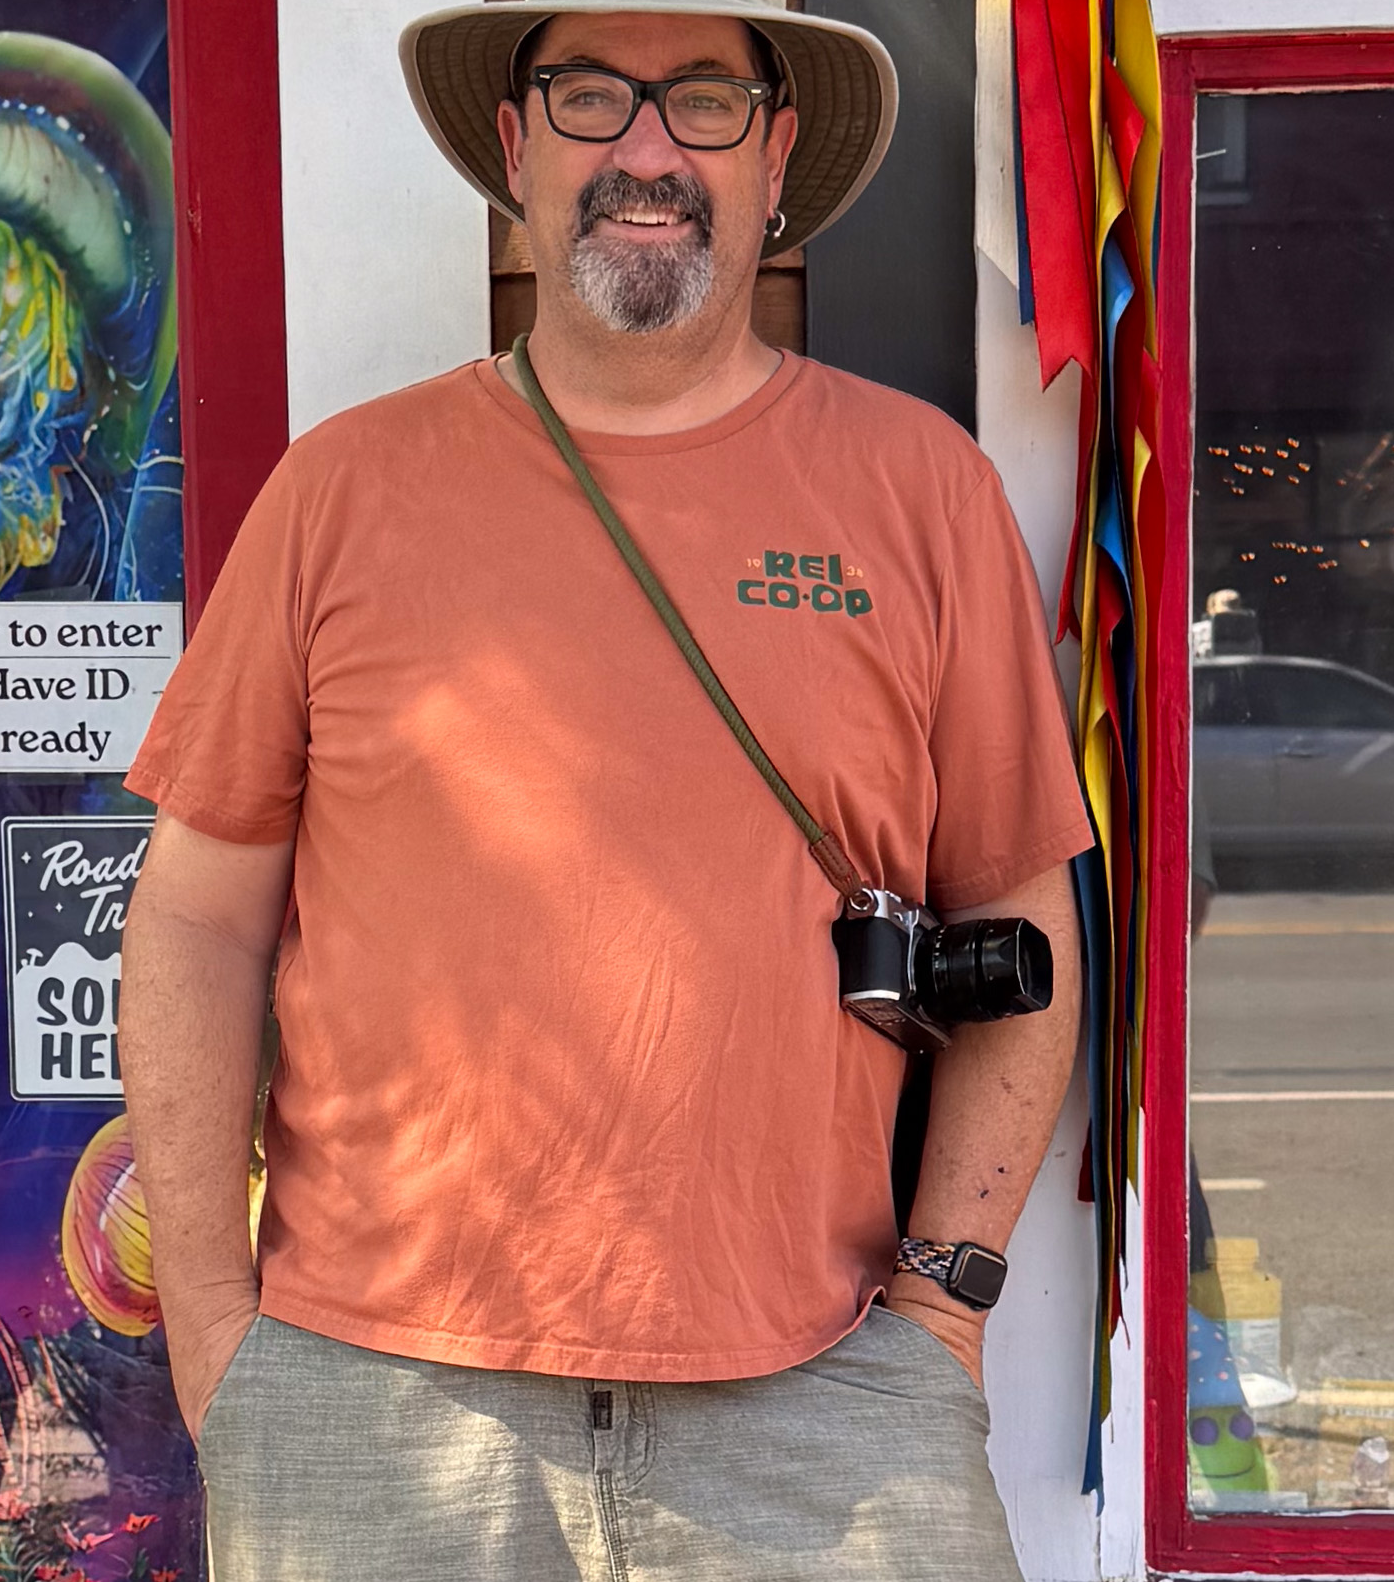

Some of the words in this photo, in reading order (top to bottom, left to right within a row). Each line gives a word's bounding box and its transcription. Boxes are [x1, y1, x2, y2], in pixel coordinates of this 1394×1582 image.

[763, 549, 844, 586] REI
[8, 620, 47, 648] to
[56, 621, 163, 648] enter
[85, 669, 131, 701] ID
[0, 722, 112, 762] ready
[39, 837, 149, 892] Road
